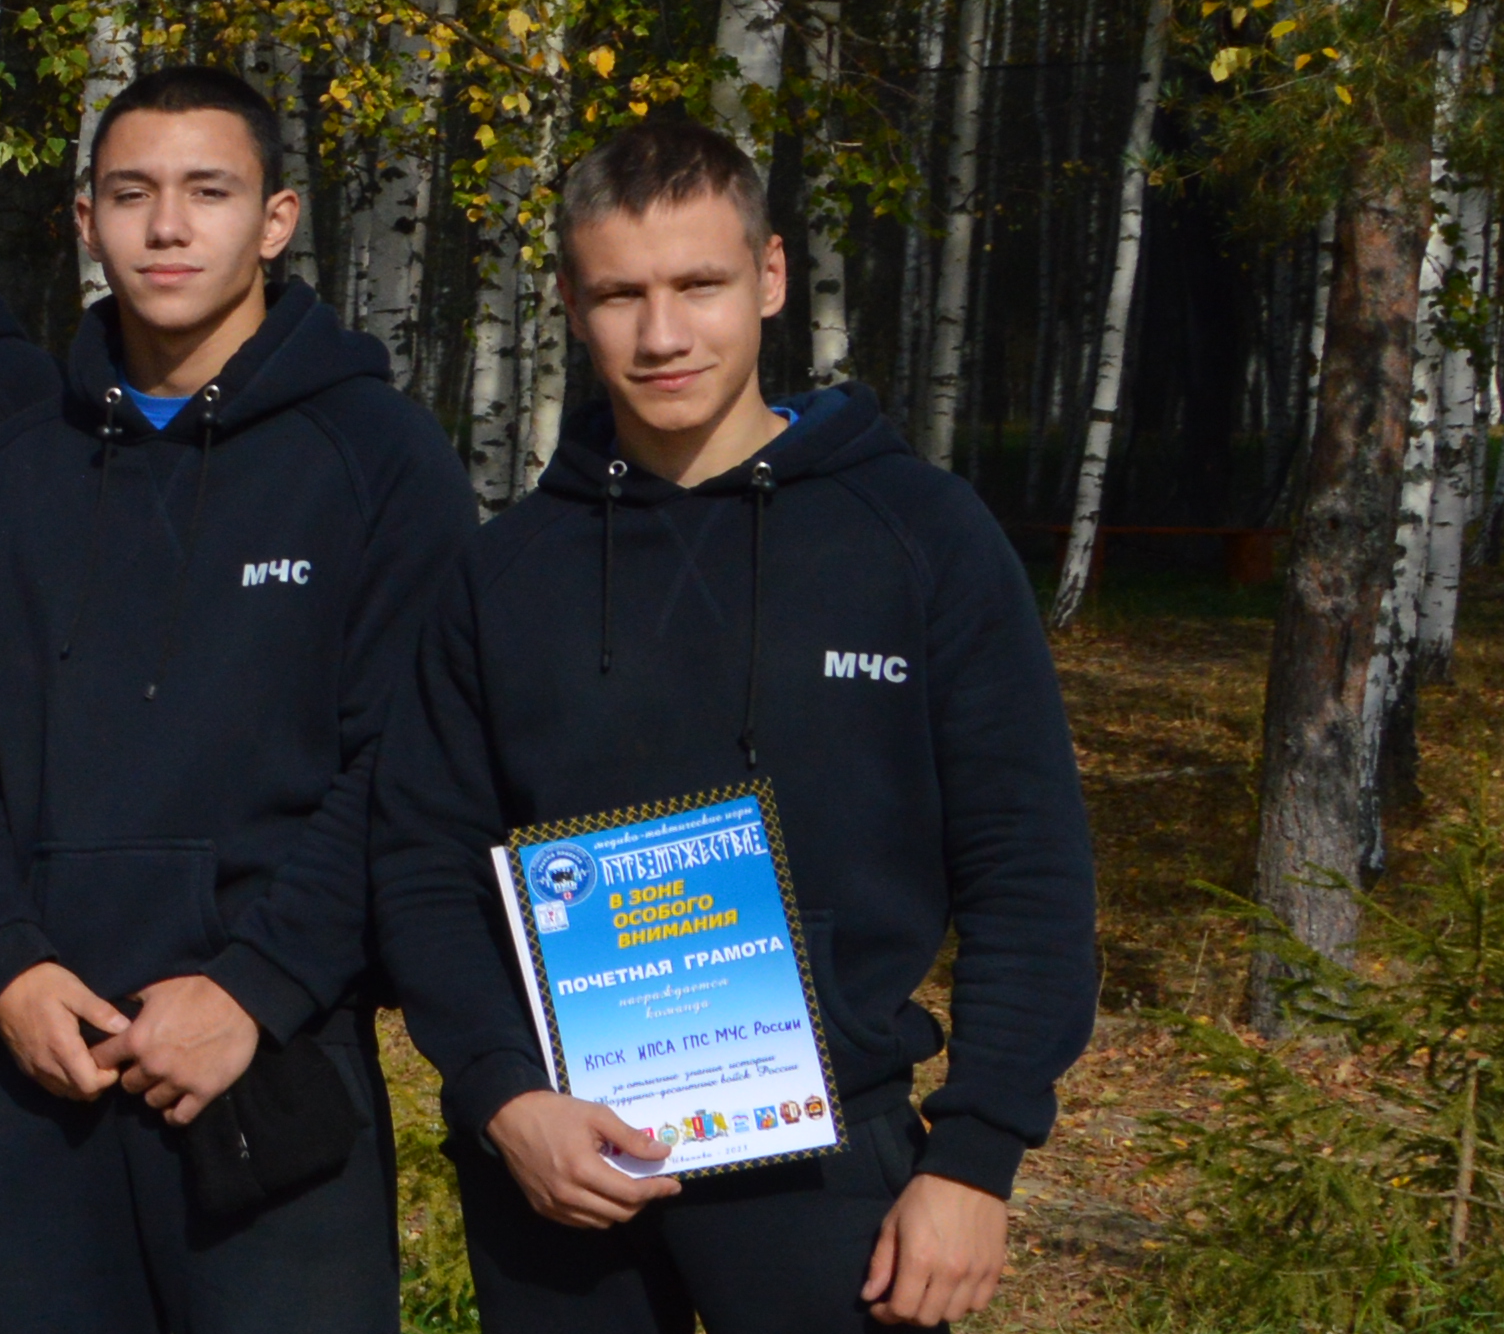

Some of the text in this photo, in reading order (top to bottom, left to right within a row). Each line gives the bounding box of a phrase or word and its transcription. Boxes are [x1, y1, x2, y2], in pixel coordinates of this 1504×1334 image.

[241, 557, 312, 588] МЧС
[823, 649, 909, 685] МЧС
[609, 878, 686, 910] В ЗОНЕ
[613, 893, 714, 930] ОСОБОГО
[618, 908, 738, 949] ВНИМАНИЯ
[557, 935, 785, 996] ПОЧЕТНАЯ ГРАМОТА
[715, 1025, 749, 1045] МЧС
